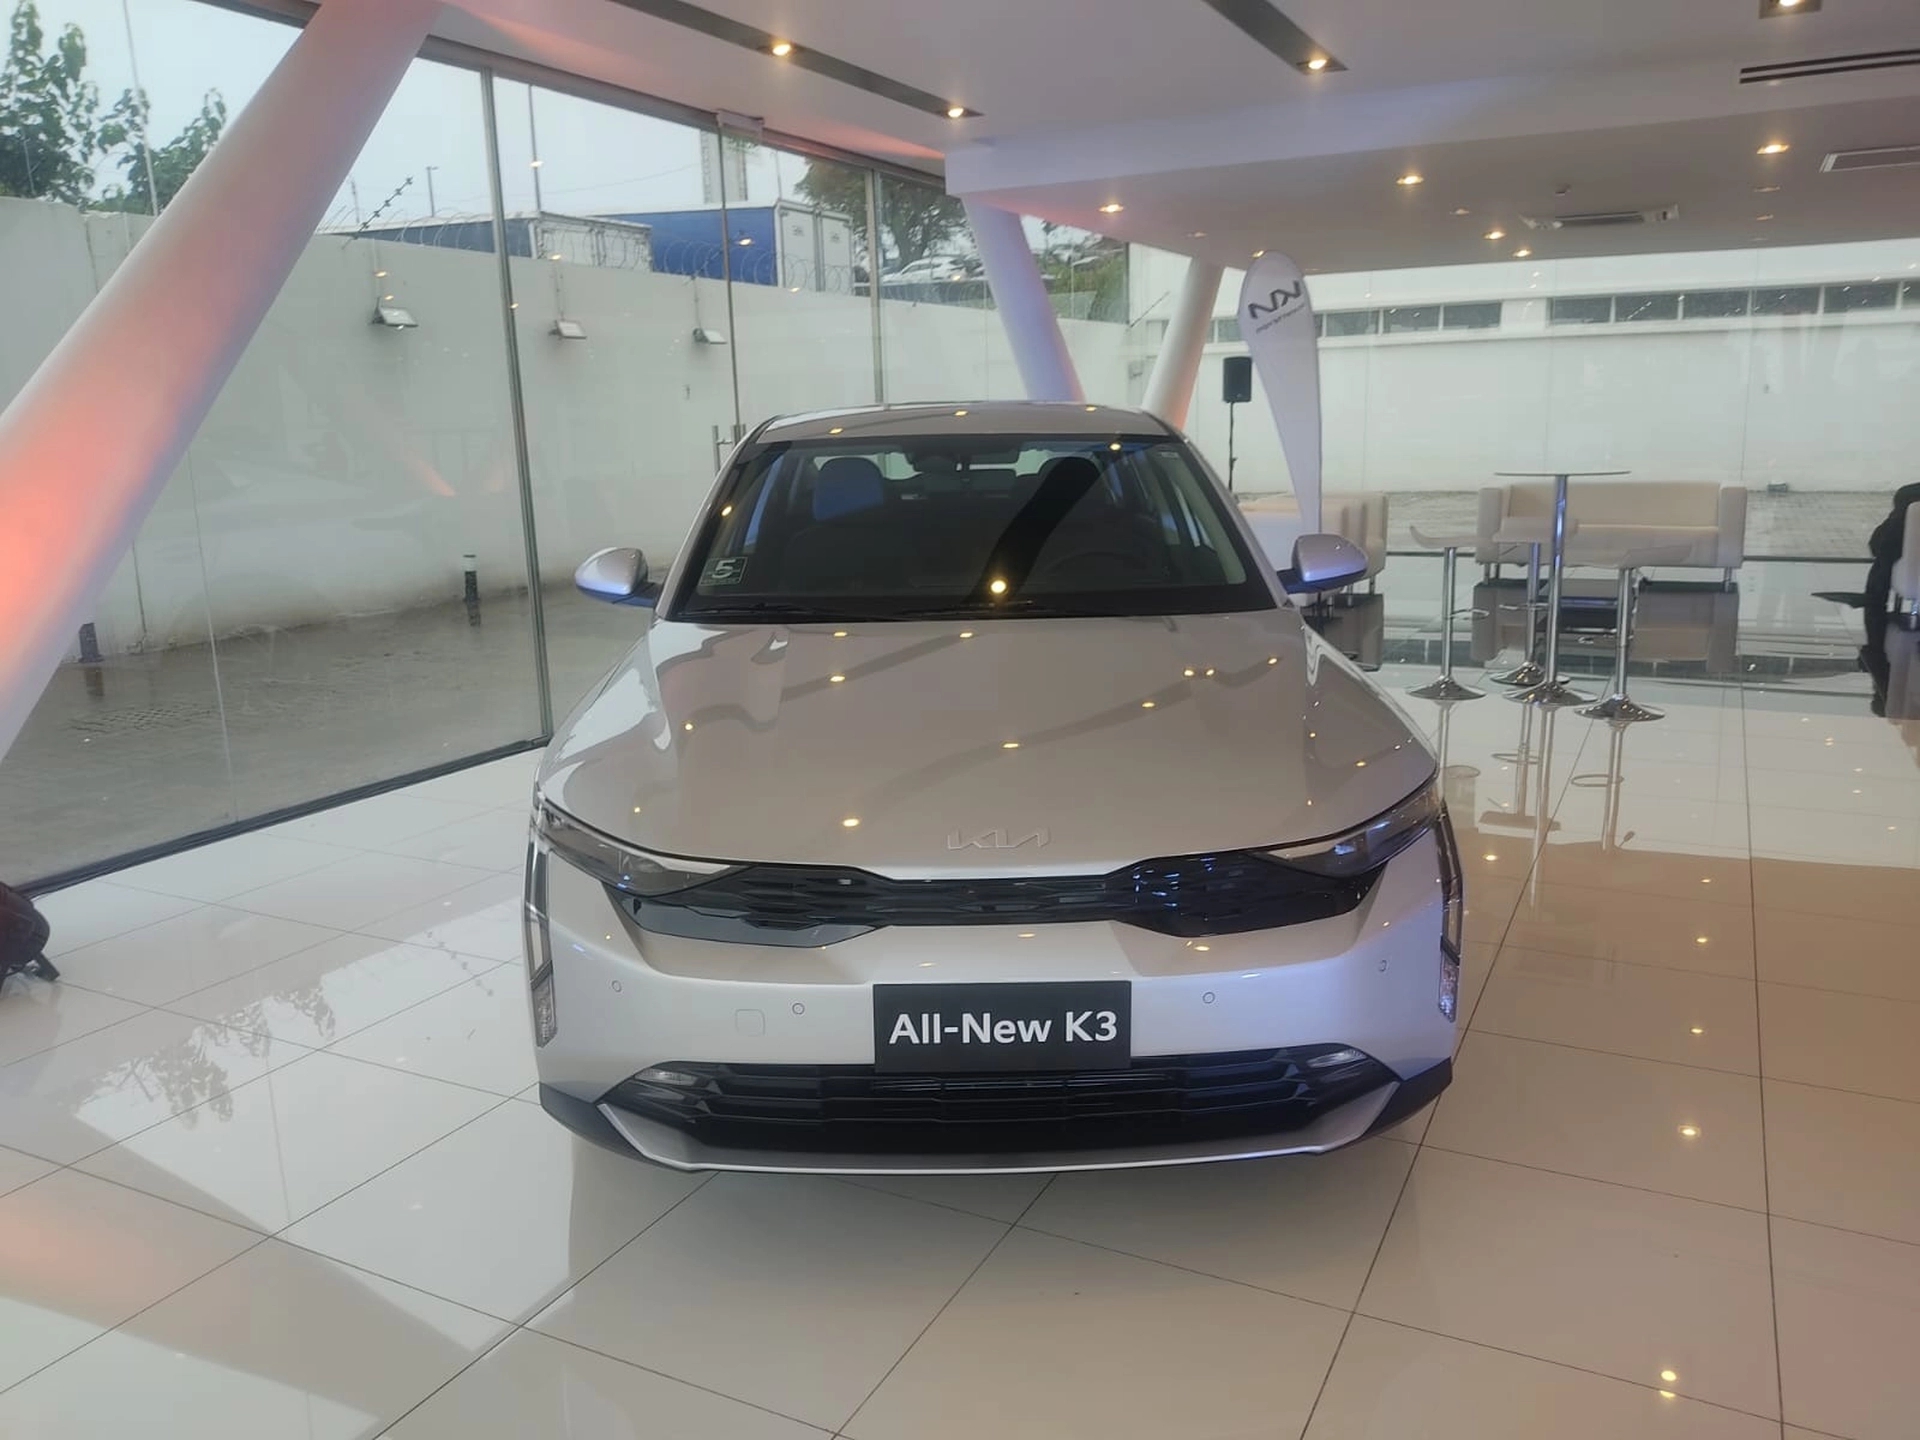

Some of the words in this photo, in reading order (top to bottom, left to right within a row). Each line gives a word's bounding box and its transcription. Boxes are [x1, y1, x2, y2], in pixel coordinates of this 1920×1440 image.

[947, 827, 1051, 850] KIA
[889, 1012, 1052, 1044] All-New
[1065, 1011, 1117, 1042] K3
